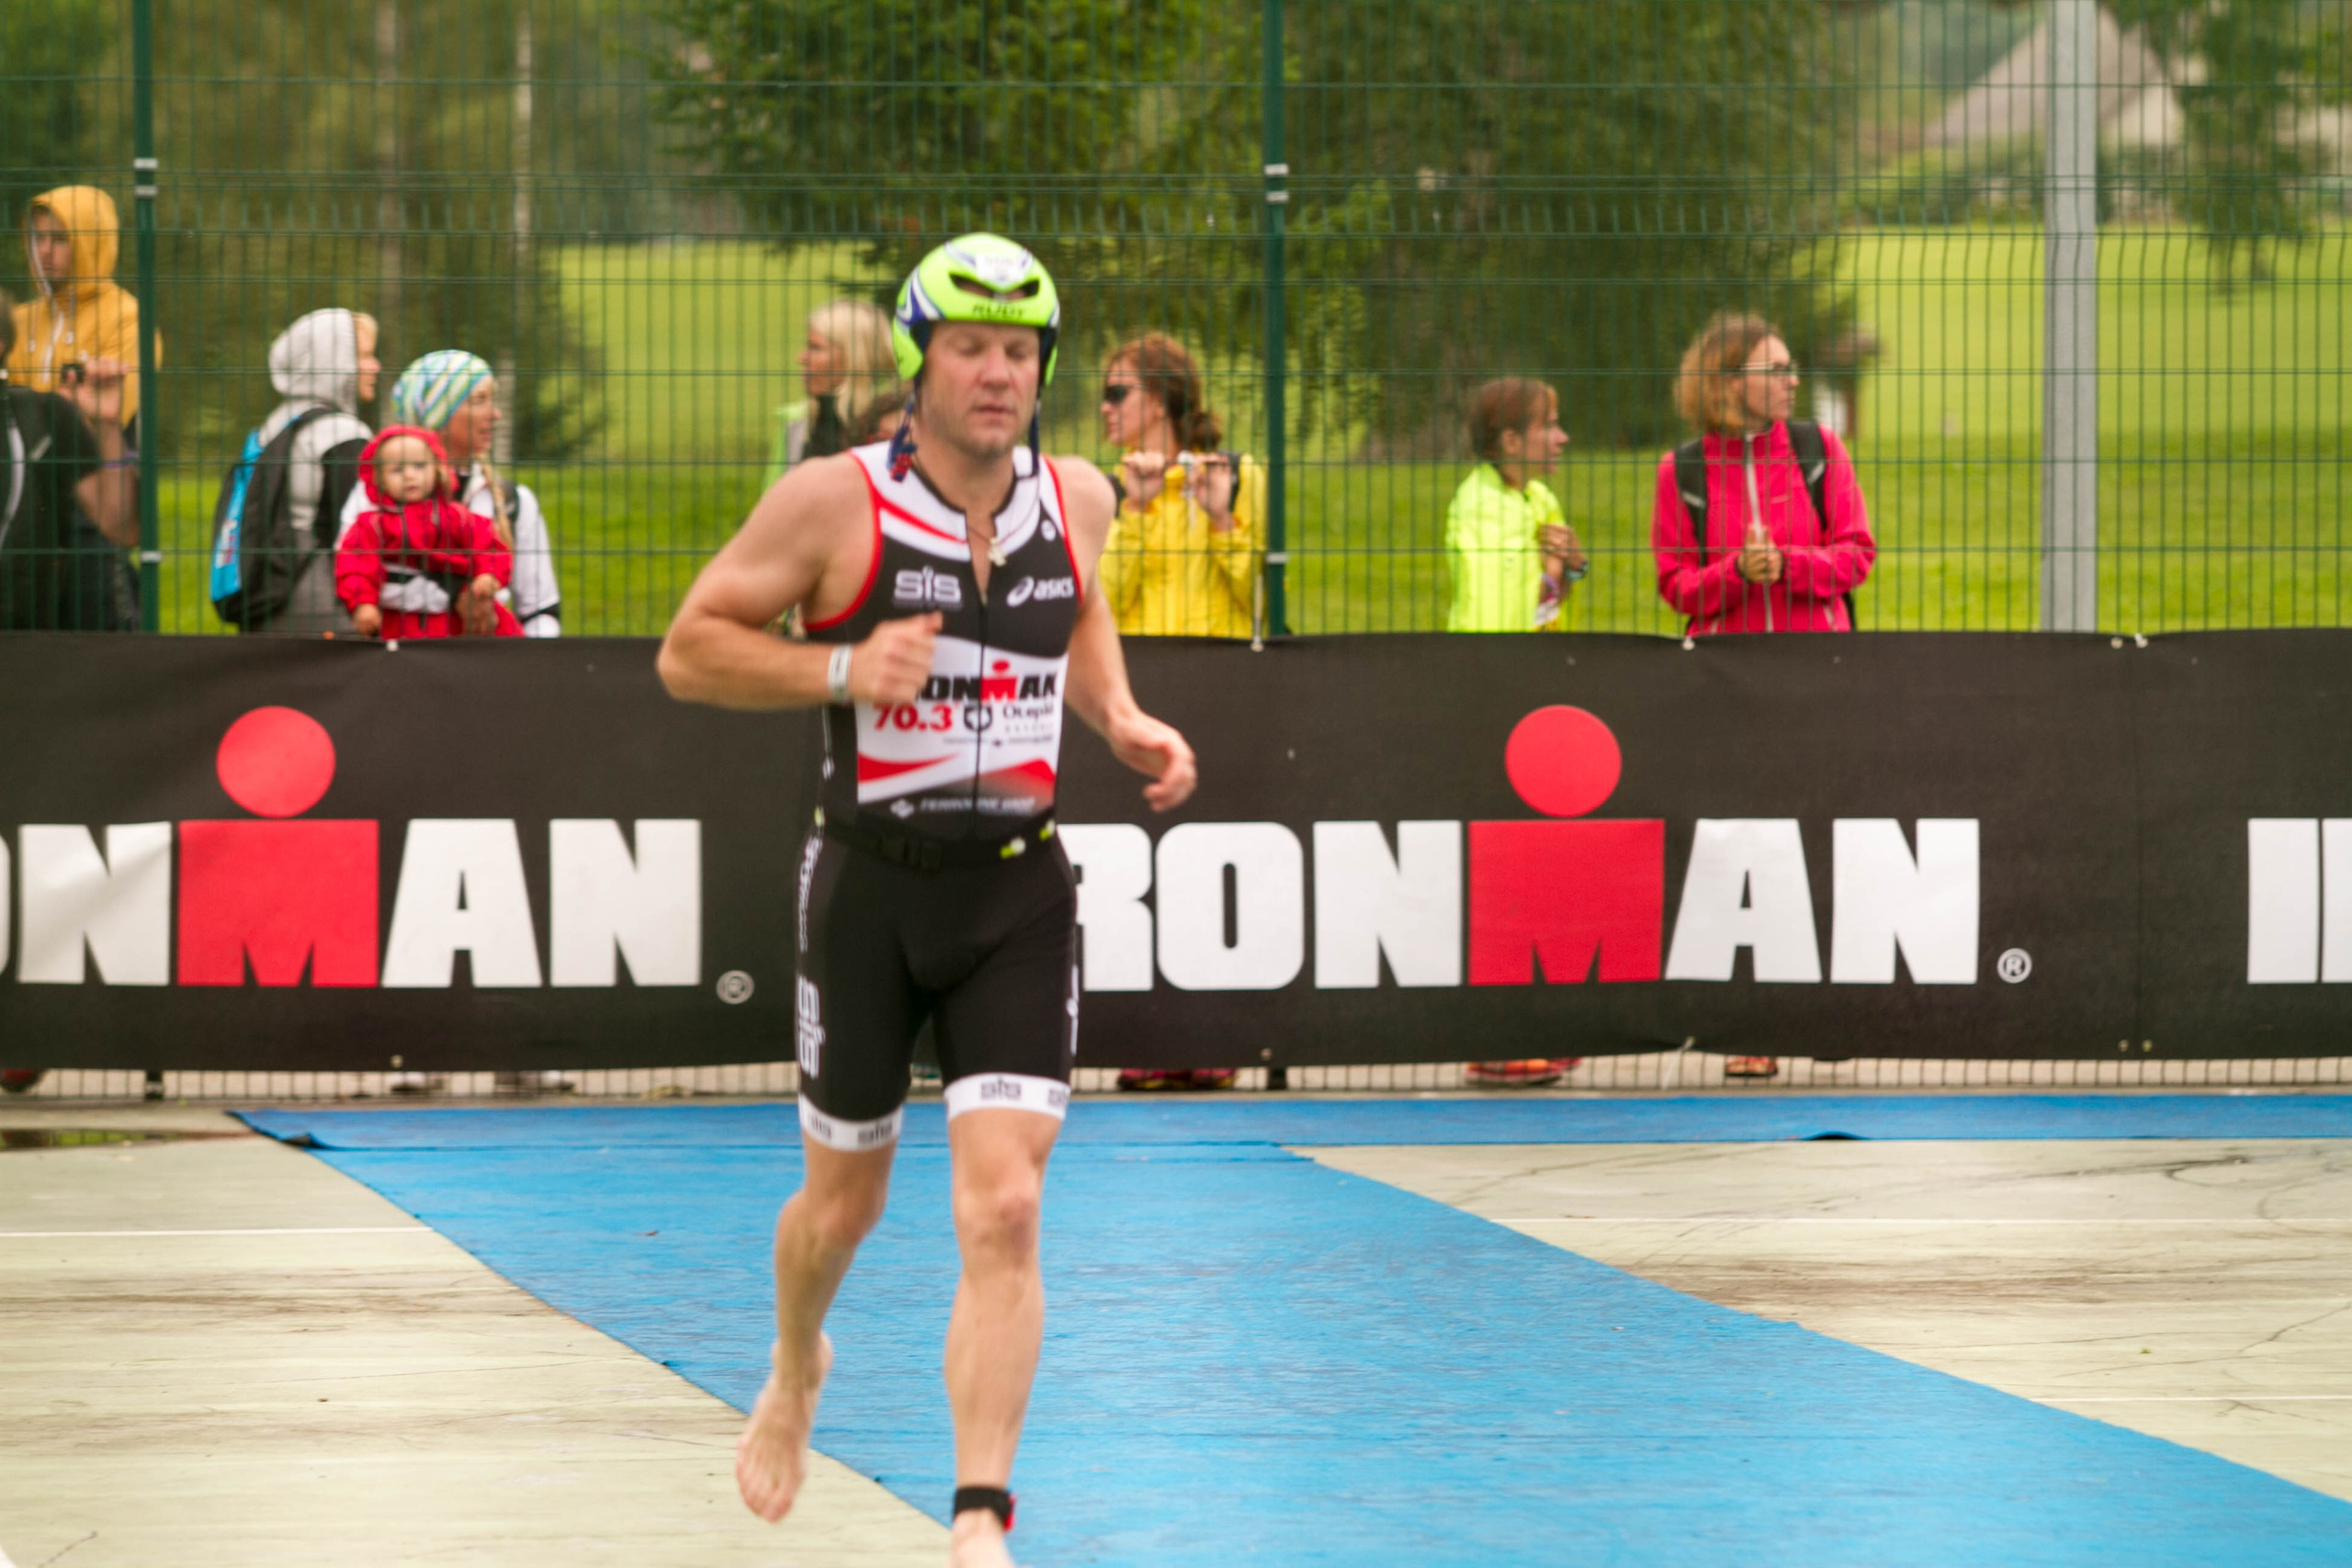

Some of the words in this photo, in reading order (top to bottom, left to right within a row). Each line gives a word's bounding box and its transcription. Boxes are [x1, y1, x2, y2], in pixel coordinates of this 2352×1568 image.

[875, 702, 952, 732] 70.3
[919, 674, 1056, 701] ONMAN
[0, 819, 701, 988] NMAN
[1057, 818, 1979, 990] RONMAN
